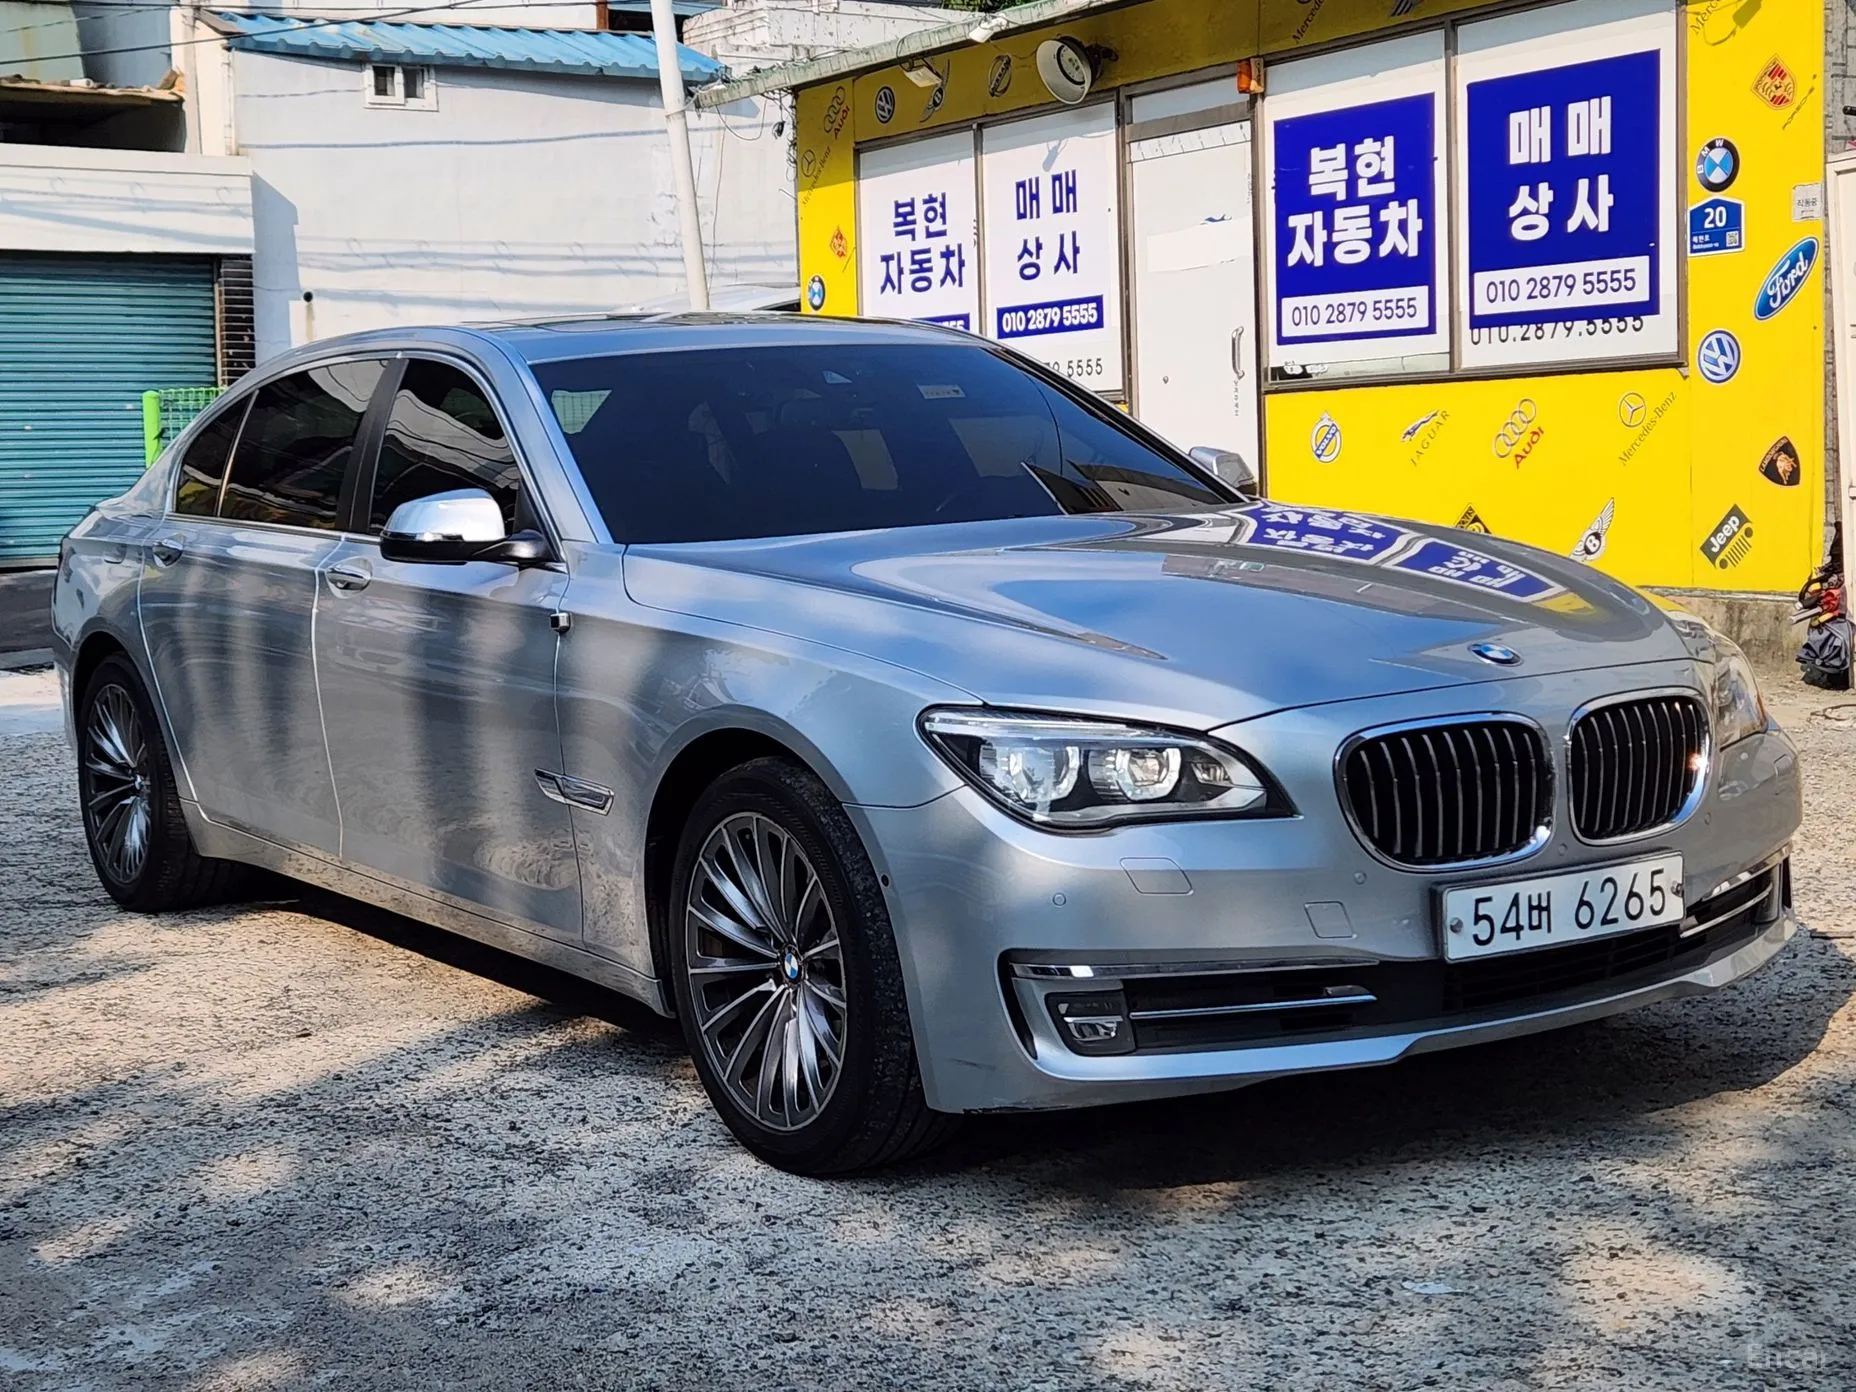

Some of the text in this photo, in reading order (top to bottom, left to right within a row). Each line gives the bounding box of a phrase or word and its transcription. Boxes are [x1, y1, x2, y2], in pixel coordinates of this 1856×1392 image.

[1308, 136, 1396, 201] 복현
[893, 192, 947, 241] 복현
[1287, 199, 1423, 267] 자동차
[1704, 206, 1727, 229] 20
[880, 243, 965, 295] 자동차
[1486, 268, 1636, 303] 010 2879 5555
[1767, 250, 1809, 308] Ford
[1002, 303, 1098, 333] 010 2879 5555
[1292, 297, 1417, 327] 010 2879 5555
[1315, 423, 1338, 457] VOLVO
[1410, 410, 1450, 467] JAGUAR
[1514, 427, 1544, 469] Audi
[1617, 391, 1677, 466] Mercedes-Benz
[1710, 515, 1740, 552] Jeep
[1472, 868, 1666, 946] 54버 6265
